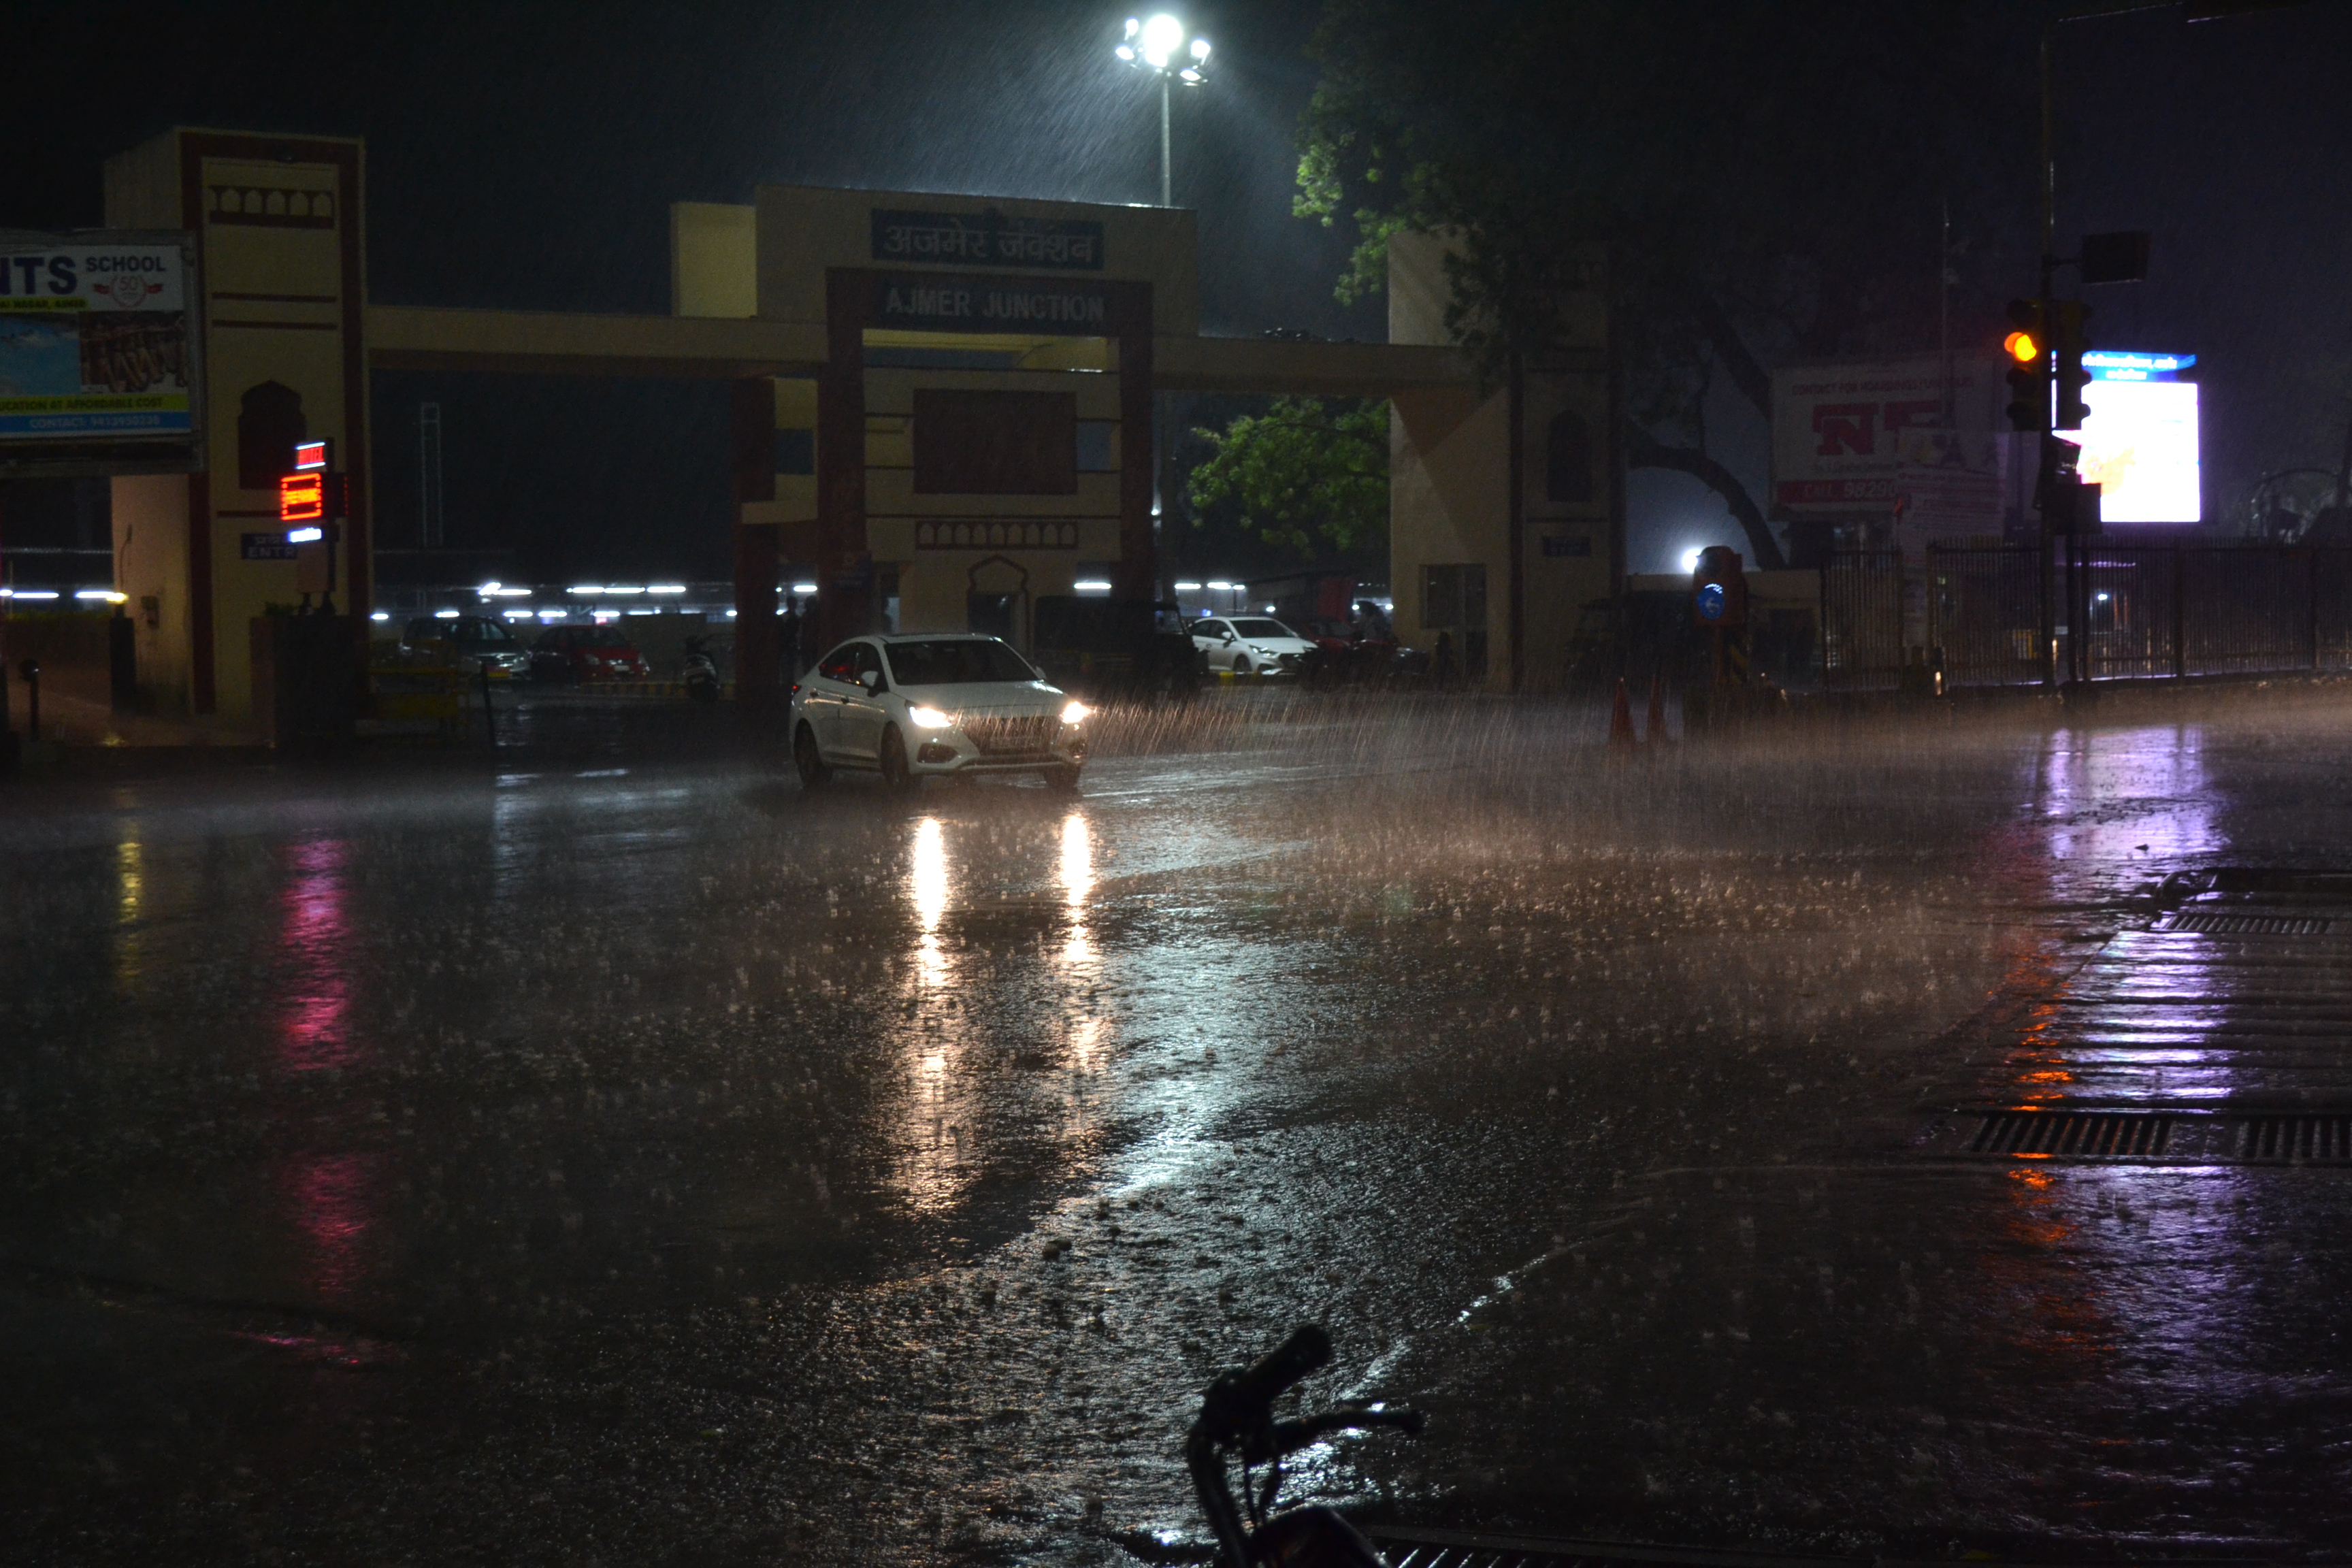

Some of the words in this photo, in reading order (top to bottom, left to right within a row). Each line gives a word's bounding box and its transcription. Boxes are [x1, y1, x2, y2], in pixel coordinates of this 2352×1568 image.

[884, 215, 989, 259] अजमेर
[996, 220, 1097, 264] जंक्शन
[85, 255, 167, 272] SCHOOL
[885, 286, 971, 318] AJMER
[982, 292, 1105, 323] JUNCTION
[135, 397, 163, 408] COST
